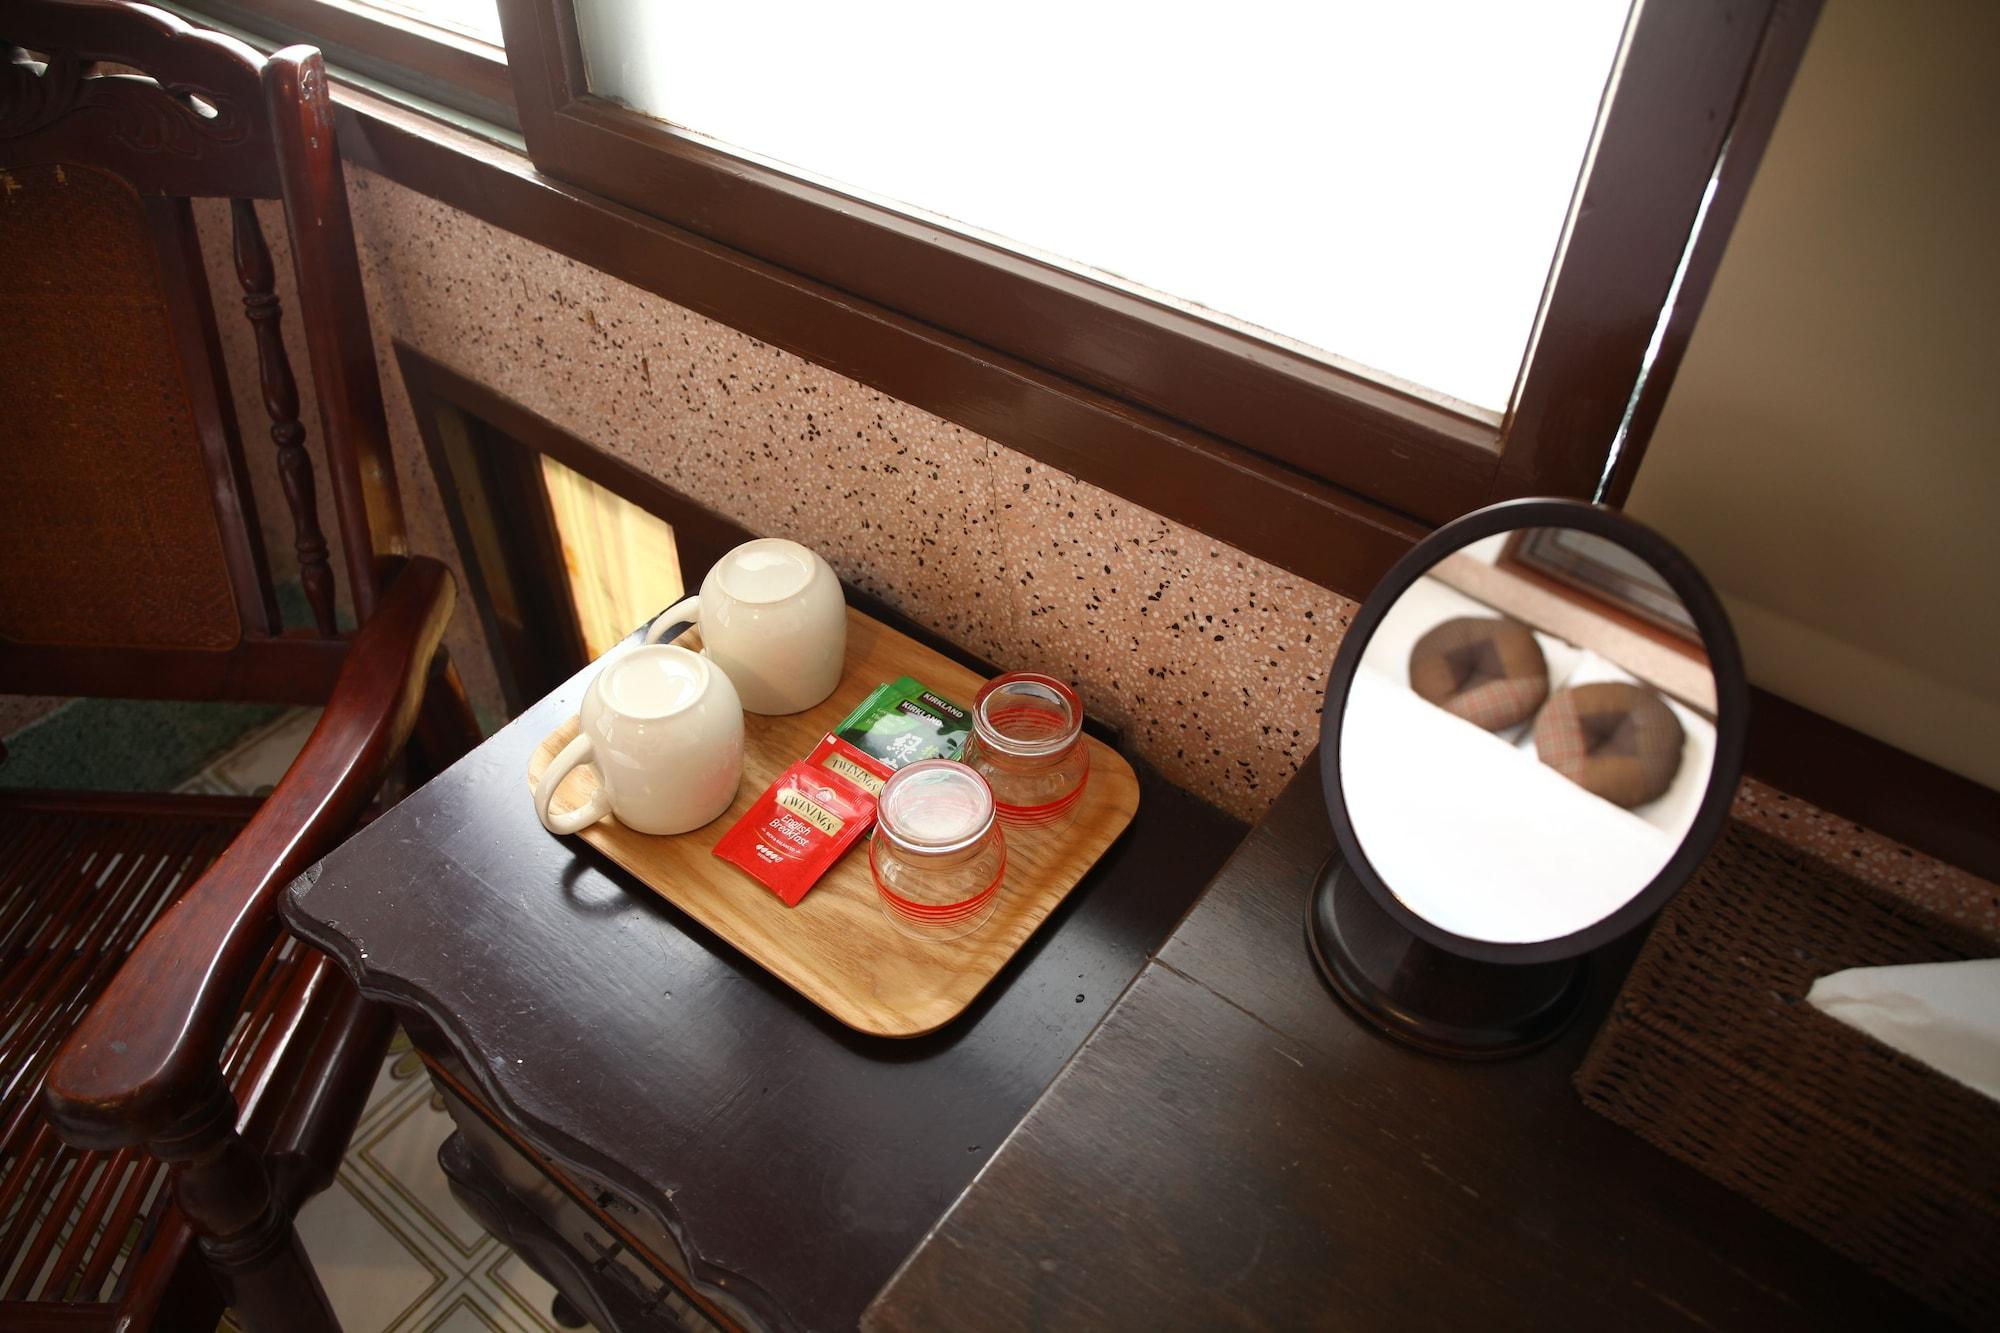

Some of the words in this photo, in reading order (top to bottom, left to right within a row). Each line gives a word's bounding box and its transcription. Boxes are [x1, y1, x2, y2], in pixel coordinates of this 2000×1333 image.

[901, 701, 944, 728] KIRKLAND
[922, 692, 964, 719] KIRKLAND
[832, 758, 879, 793] TWININGS
[781, 814, 812, 836] English
[782, 795, 836, 832] TWININGS
[769, 818, 810, 847] Breakfast
